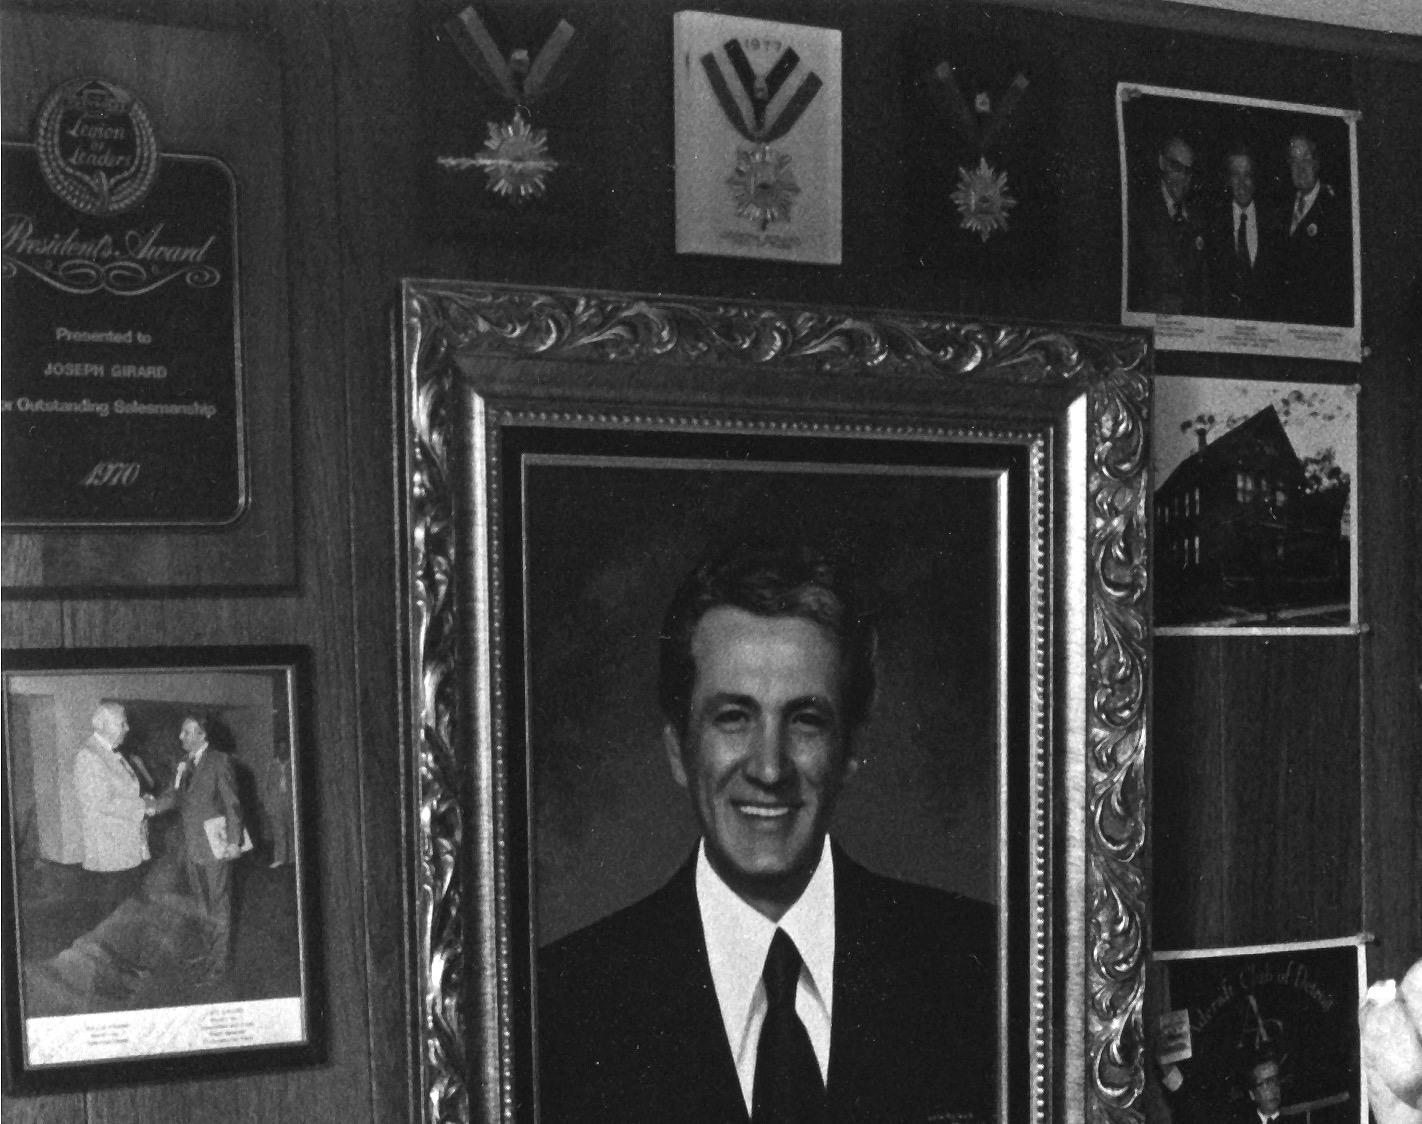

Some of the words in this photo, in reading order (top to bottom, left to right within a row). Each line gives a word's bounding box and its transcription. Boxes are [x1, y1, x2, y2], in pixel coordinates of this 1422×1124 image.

[67, 117, 125, 139] Legion
[67, 149, 131, 167] Leaders
[125, 222, 216, 262] Award
[56, 326, 133, 344] Presented
[136, 330, 153, 345] to
[44, 361, 105, 377] JOSEPH
[110, 363, 168, 379] GIRARD
[16, 396, 110, 417] Outstanding
[113, 398, 217, 419] Salesmanship
[80, 461, 141, 487] 1970
